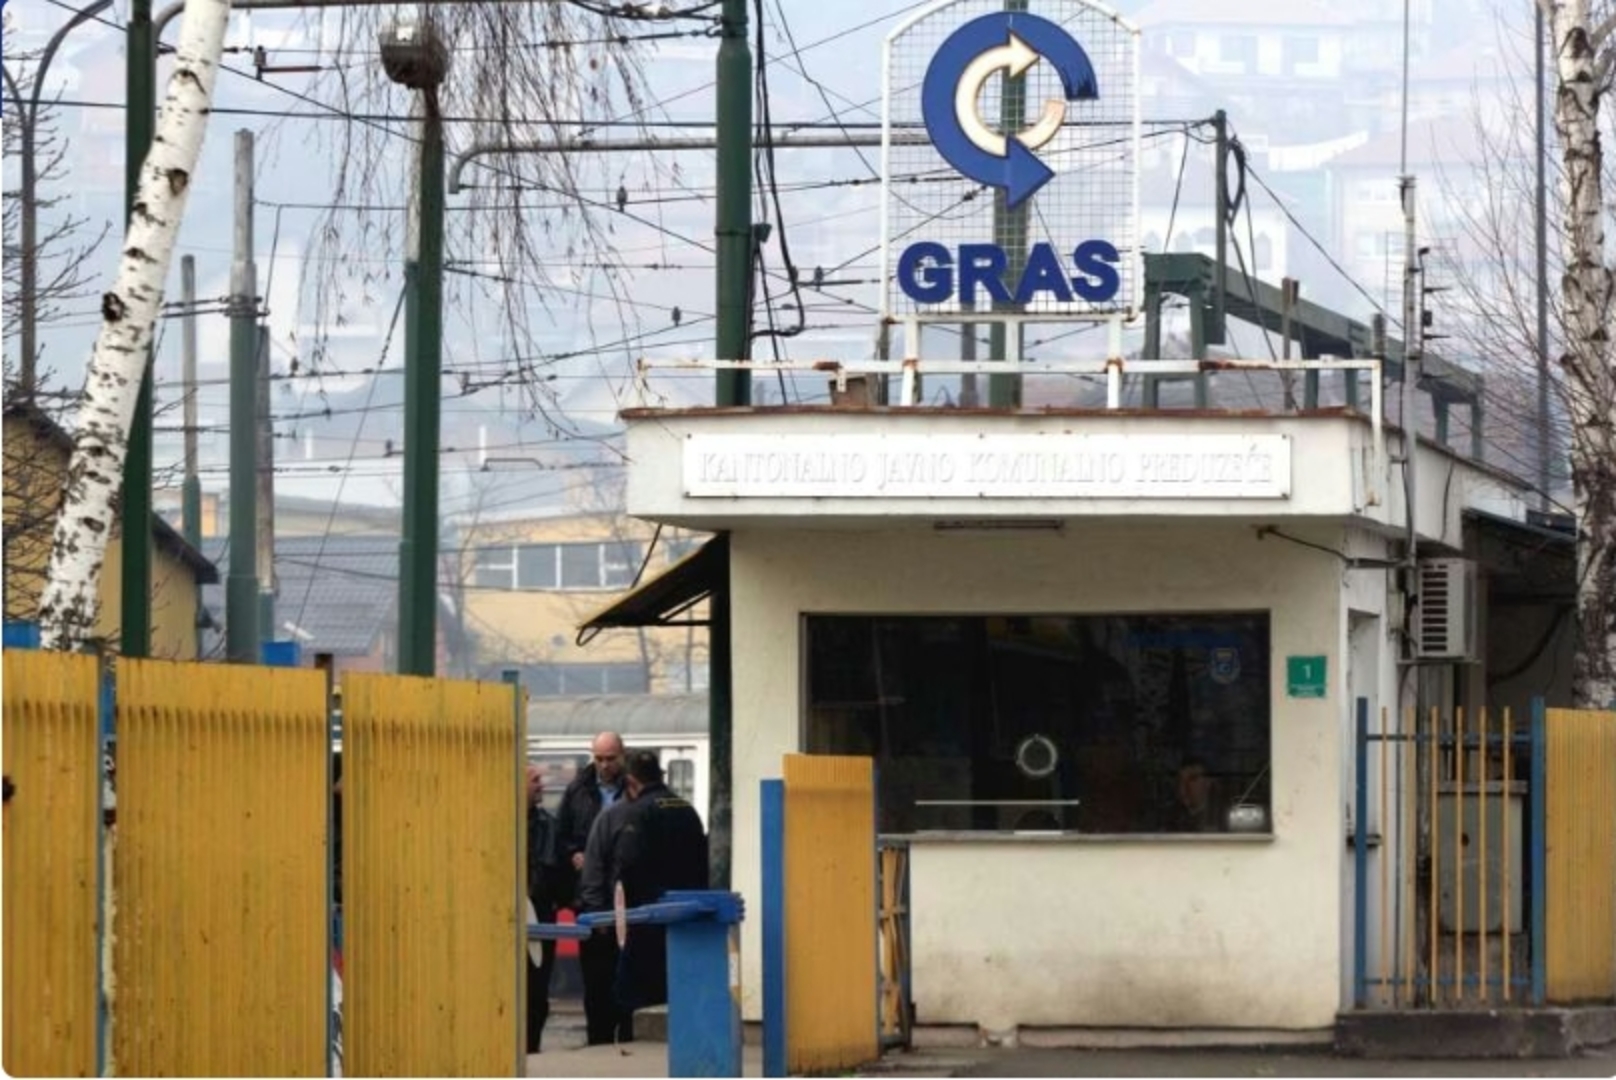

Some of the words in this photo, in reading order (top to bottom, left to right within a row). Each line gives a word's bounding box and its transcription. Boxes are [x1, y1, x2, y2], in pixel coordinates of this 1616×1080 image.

[897, 239, 1121, 304] GRAS
[699, 452, 867, 483] KANTONALNO
[877, 452, 956, 490] JAVNO
[964, 452, 1126, 483] KOMUNALNO
[1135, 442, 1273, 483] PREDUZEĆE
[1302, 664, 1311, 680] 1
